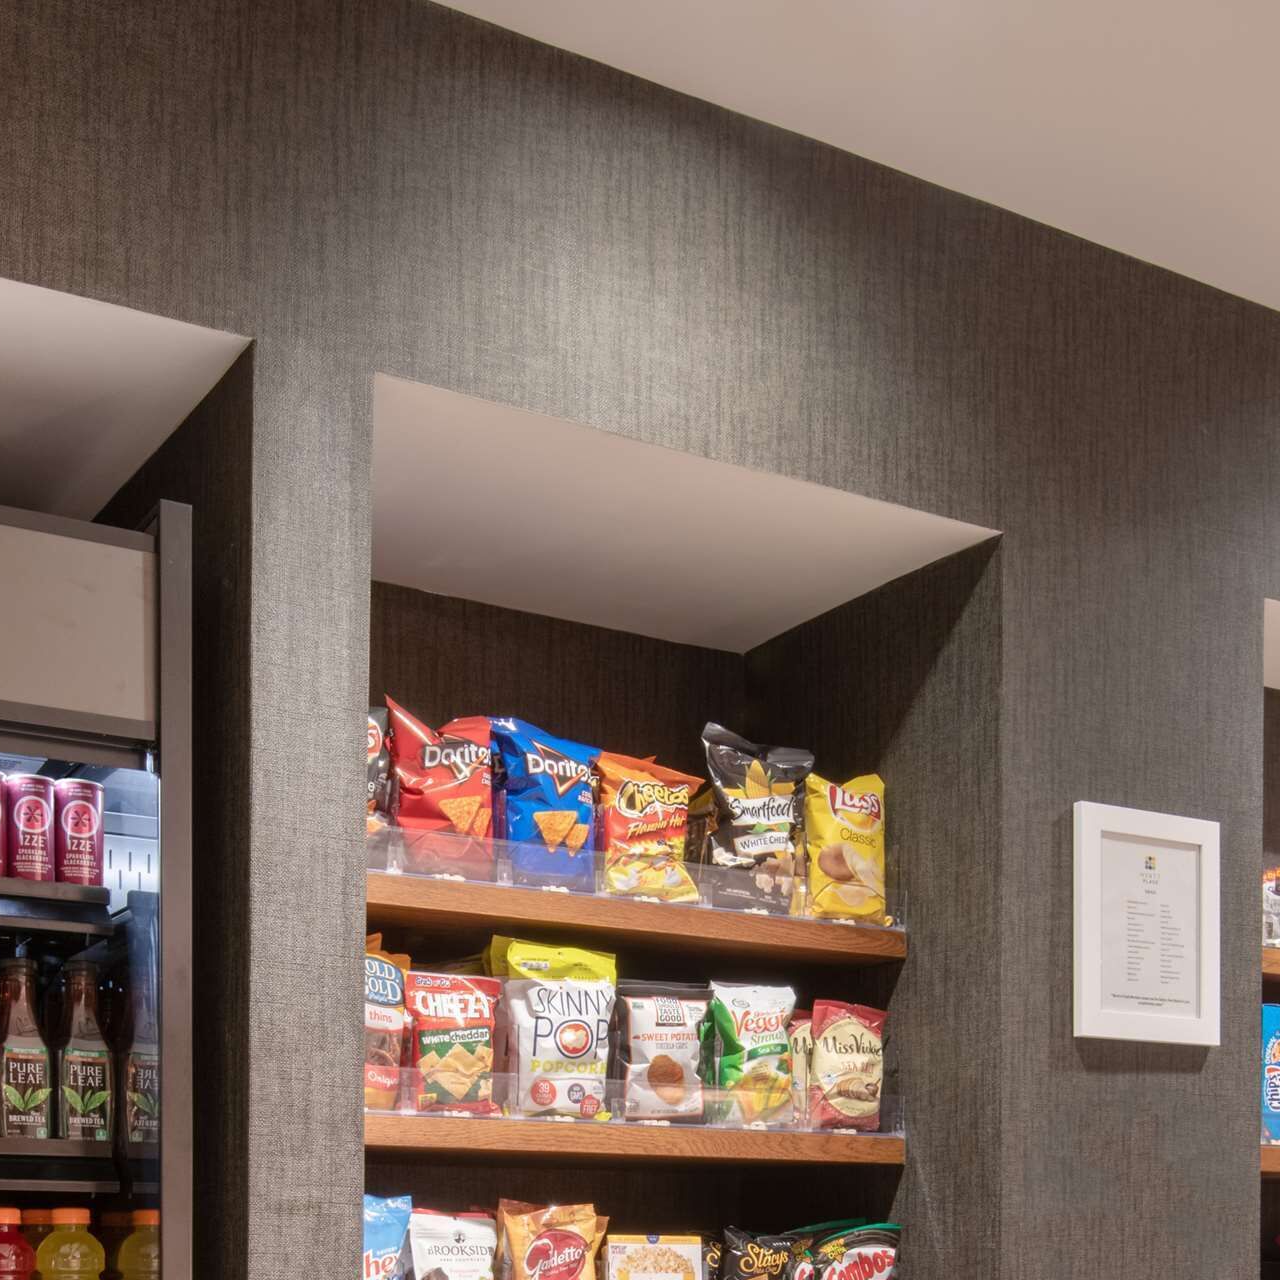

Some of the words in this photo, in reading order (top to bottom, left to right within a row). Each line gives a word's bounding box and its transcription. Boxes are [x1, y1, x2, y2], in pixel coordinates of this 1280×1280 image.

[729, 796, 795, 820] Smartfood
[20, 835, 46, 850] IZZE
[68, 839, 94, 853] IZZE
[740, 837, 768, 850] WHITE
[364, 959, 397, 981] OLD
[535, 987, 616, 1018] SKINNY
[368, 1010, 393, 1024] thins
[659, 1014, 683, 1023] GOOD
[732, 1008, 787, 1035] Veggi
[450, 1029, 490, 1043] cheddar
[532, 1016, 610, 1060] POP
[641, 1033, 669, 1042] SWEET
[822, 1036, 854, 1055] Miss
[9, 1061, 44, 1074] PURE
[70, 1064, 104, 1077] PURE
